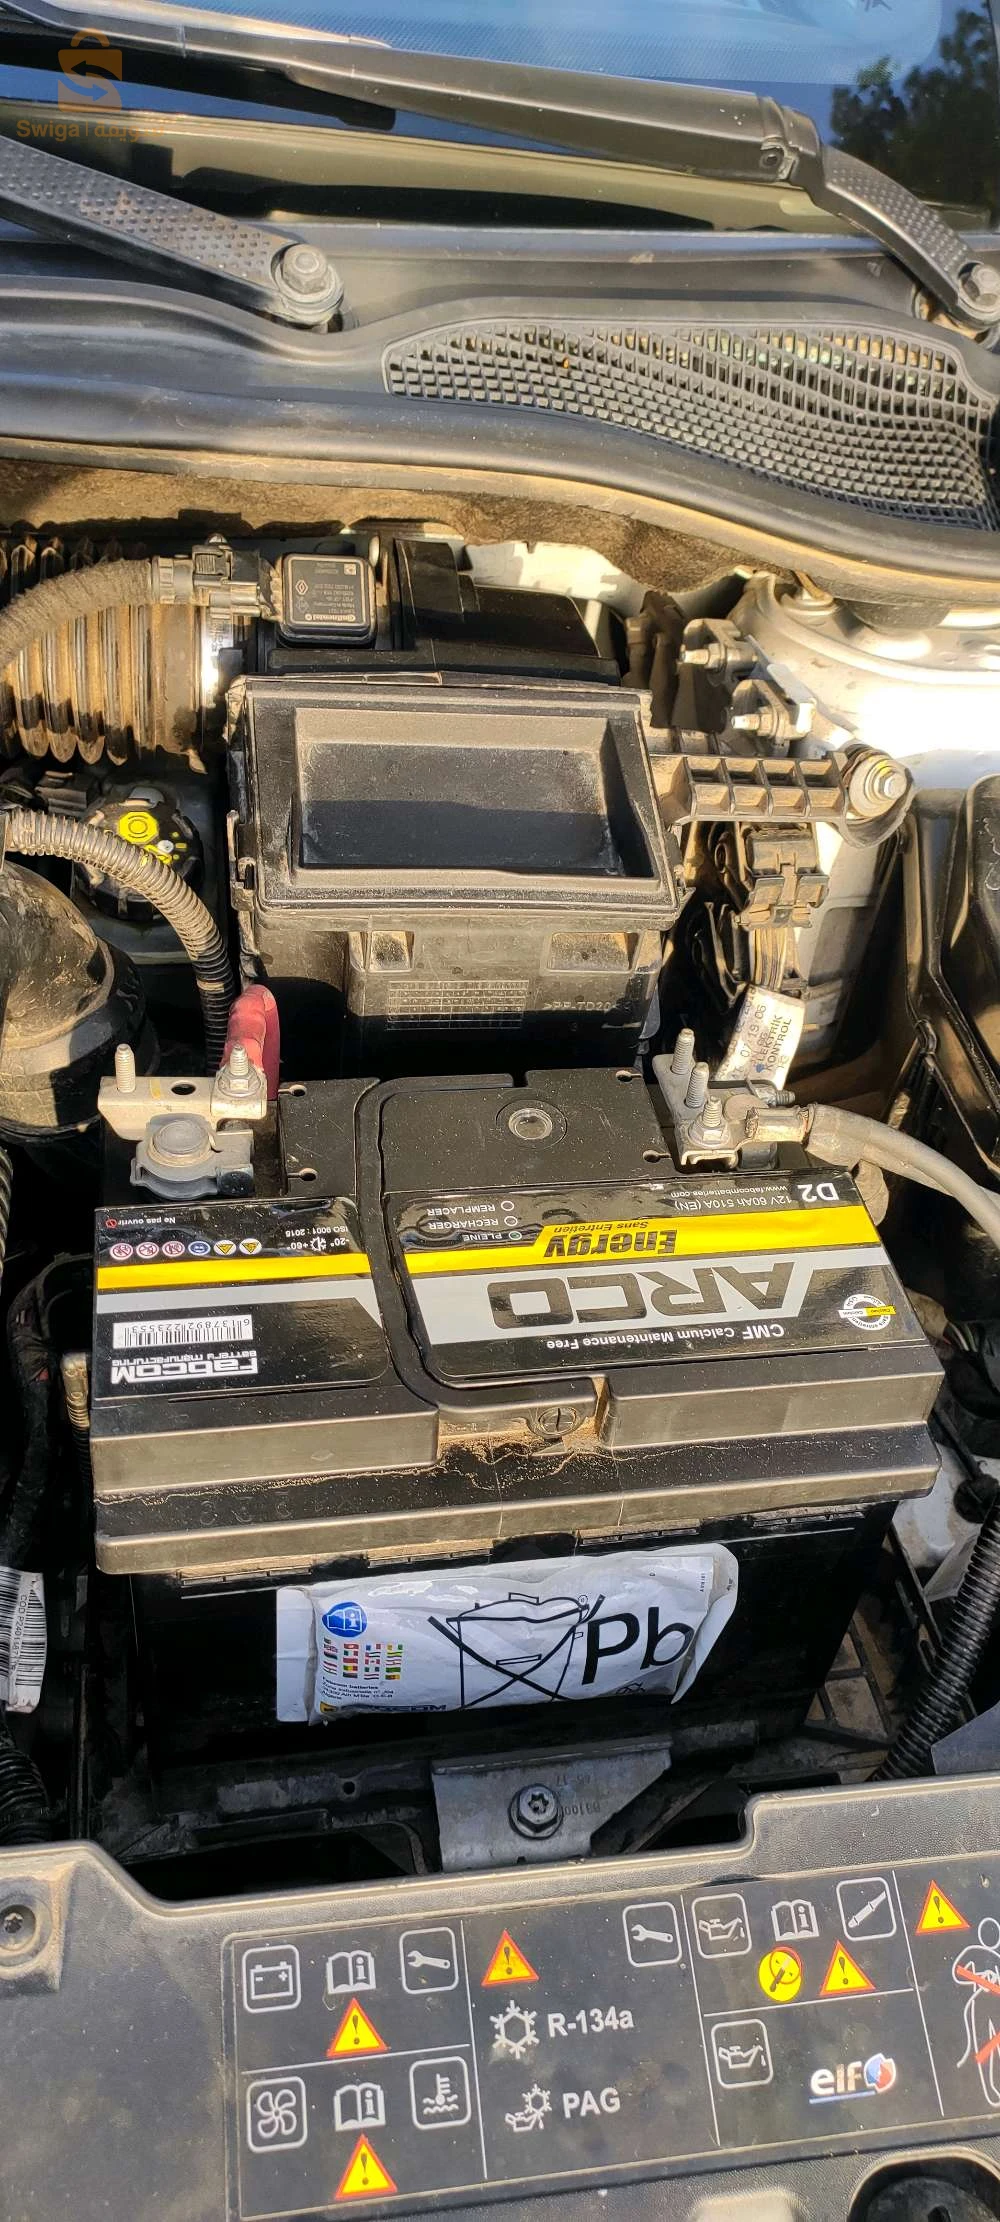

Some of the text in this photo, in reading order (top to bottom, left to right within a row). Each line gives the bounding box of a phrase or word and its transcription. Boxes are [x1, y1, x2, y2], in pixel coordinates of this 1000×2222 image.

[670, 1185, 788, 1199] www.fabcombatteries.com
[797, 1182, 840, 1203] D2
[427, 1203, 496, 1216] REMPLACER
[674, 1195, 793, 1211] 12V 60Ah 510A (EN)
[117, 1216, 176, 1226] Ne pas ouvrir
[428, 1218, 499, 1230] RECHARGER
[553, 1221, 649, 1233] Sans Entretien
[312, 1226, 332, 1235] 9001
[462, 1232, 503, 1242] PLEINE
[543, 1229, 678, 1258] Energy
[487, 1261, 796, 1330] ARCO
[546, 1323, 785, 1350] CMF Calcium Maintenance Free
[581, 1606, 696, 1686] Pb
[547, 2006, 634, 2038] R-134a
[810, 2061, 862, 2096] elf
[562, 2087, 621, 2119] PAG
